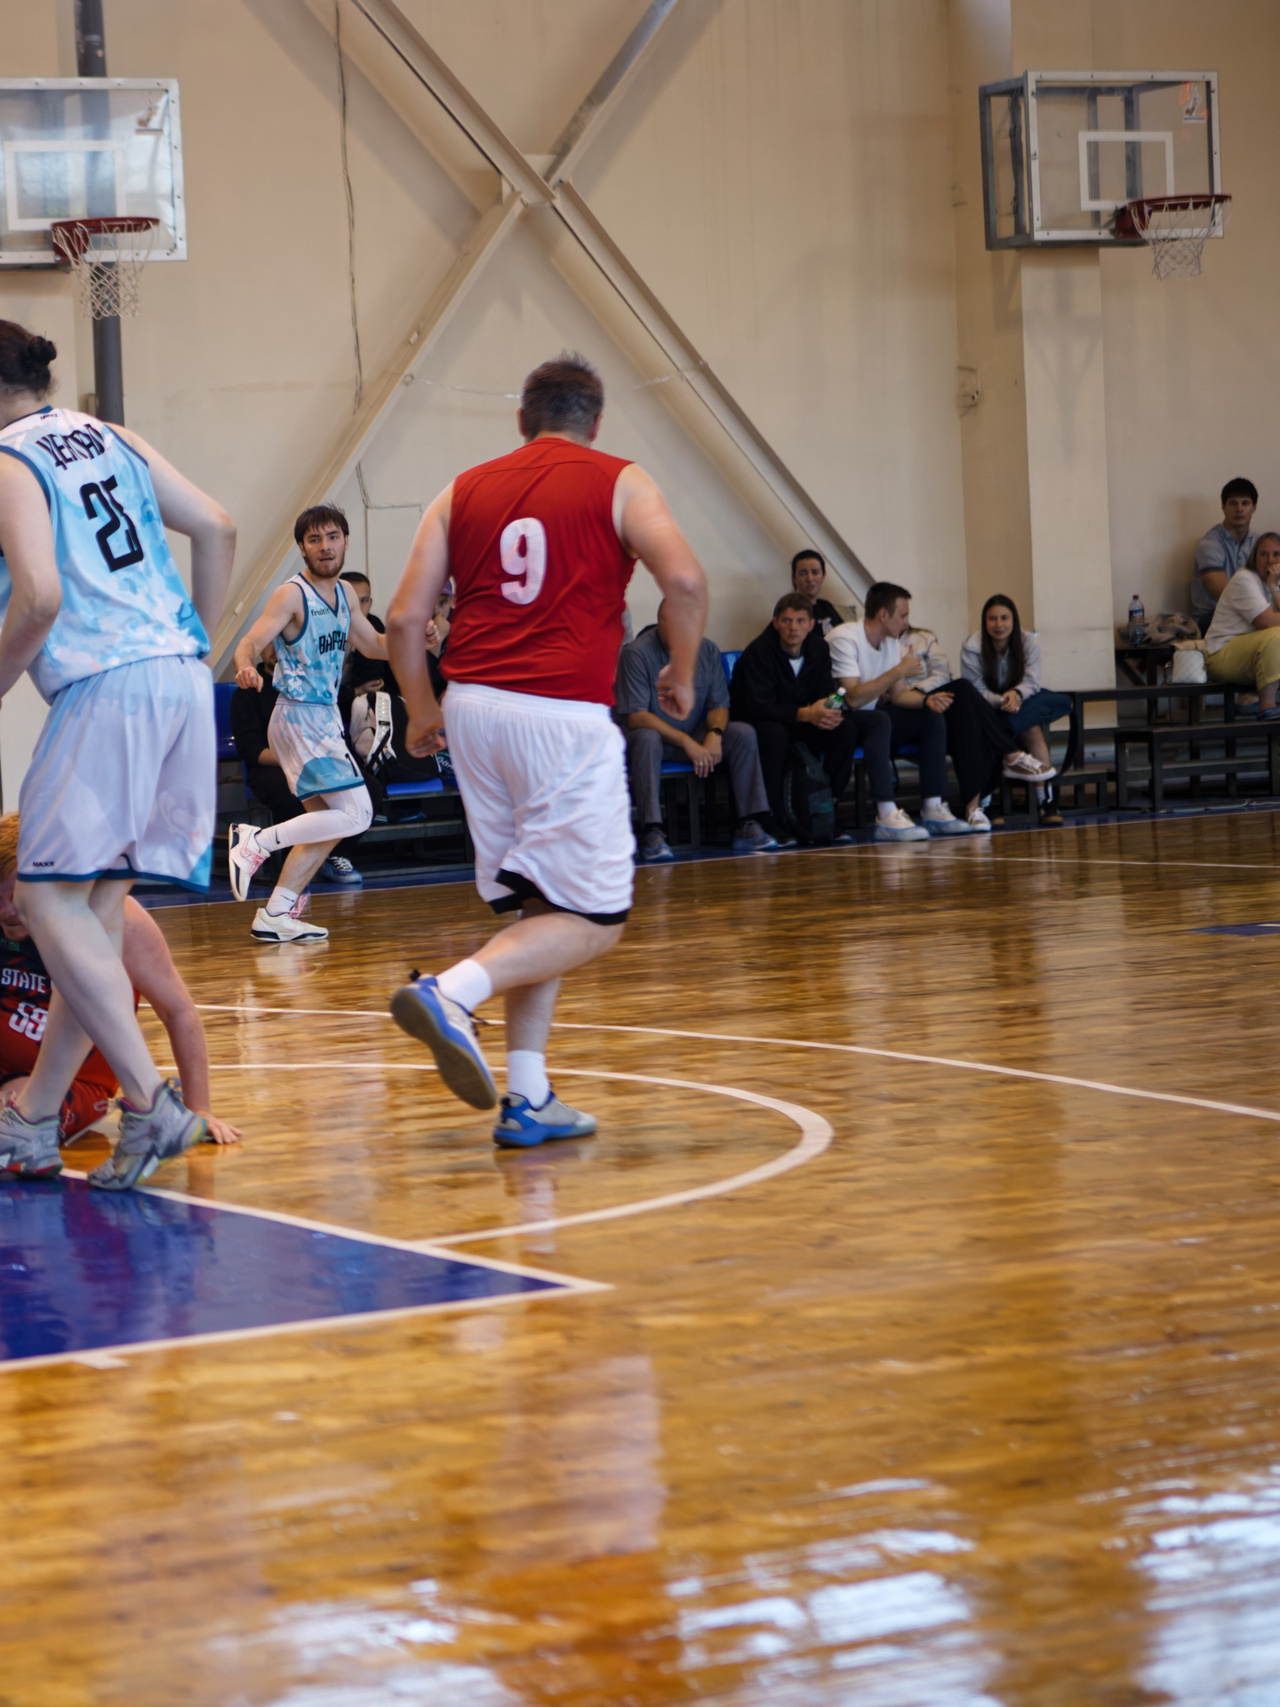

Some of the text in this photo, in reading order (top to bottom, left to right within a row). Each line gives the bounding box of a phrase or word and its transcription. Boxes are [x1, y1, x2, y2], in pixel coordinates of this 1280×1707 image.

[80, 474, 145, 573] 25
[499, 516, 547, 605] 9
[1, 967, 47, 994] STATE
